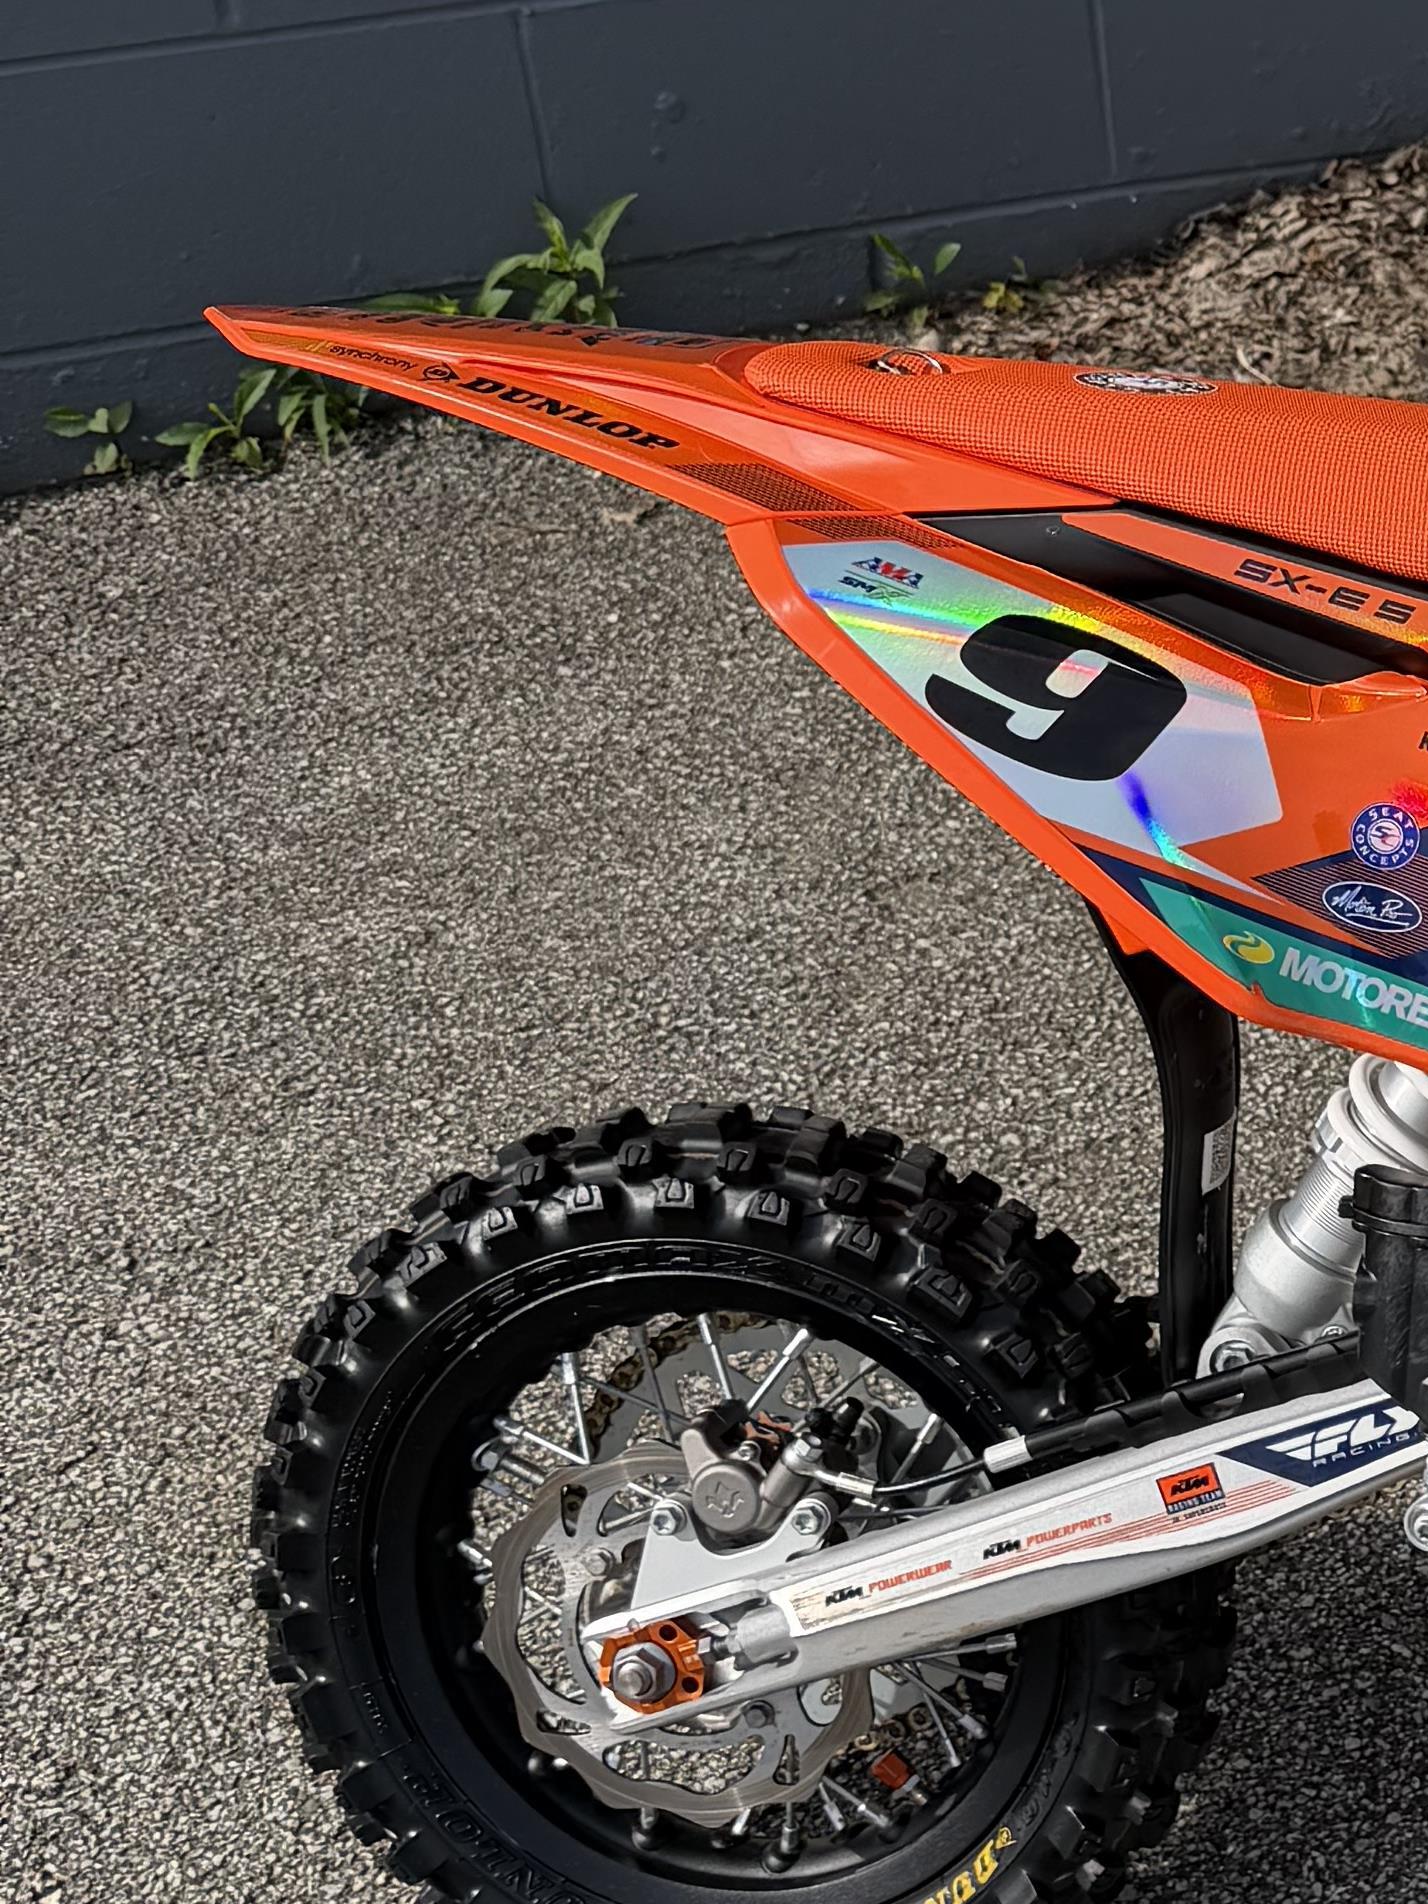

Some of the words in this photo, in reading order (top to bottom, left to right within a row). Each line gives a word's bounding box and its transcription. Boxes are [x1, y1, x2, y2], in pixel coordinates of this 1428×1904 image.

[328, 345, 419, 372] synchrony
[457, 376, 681, 449] DUNLOP
[924, 614, 1188, 782] 9
[1368, 806, 1415, 829] SEAT
[1355, 823, 1415, 866] CONCEPTS
[1266, 1406, 1420, 1461] FLY
[1170, 1473, 1211, 1497] KTM
[983, 1538, 1022, 1561] KTM
[825, 1585, 865, 1607] KTM
